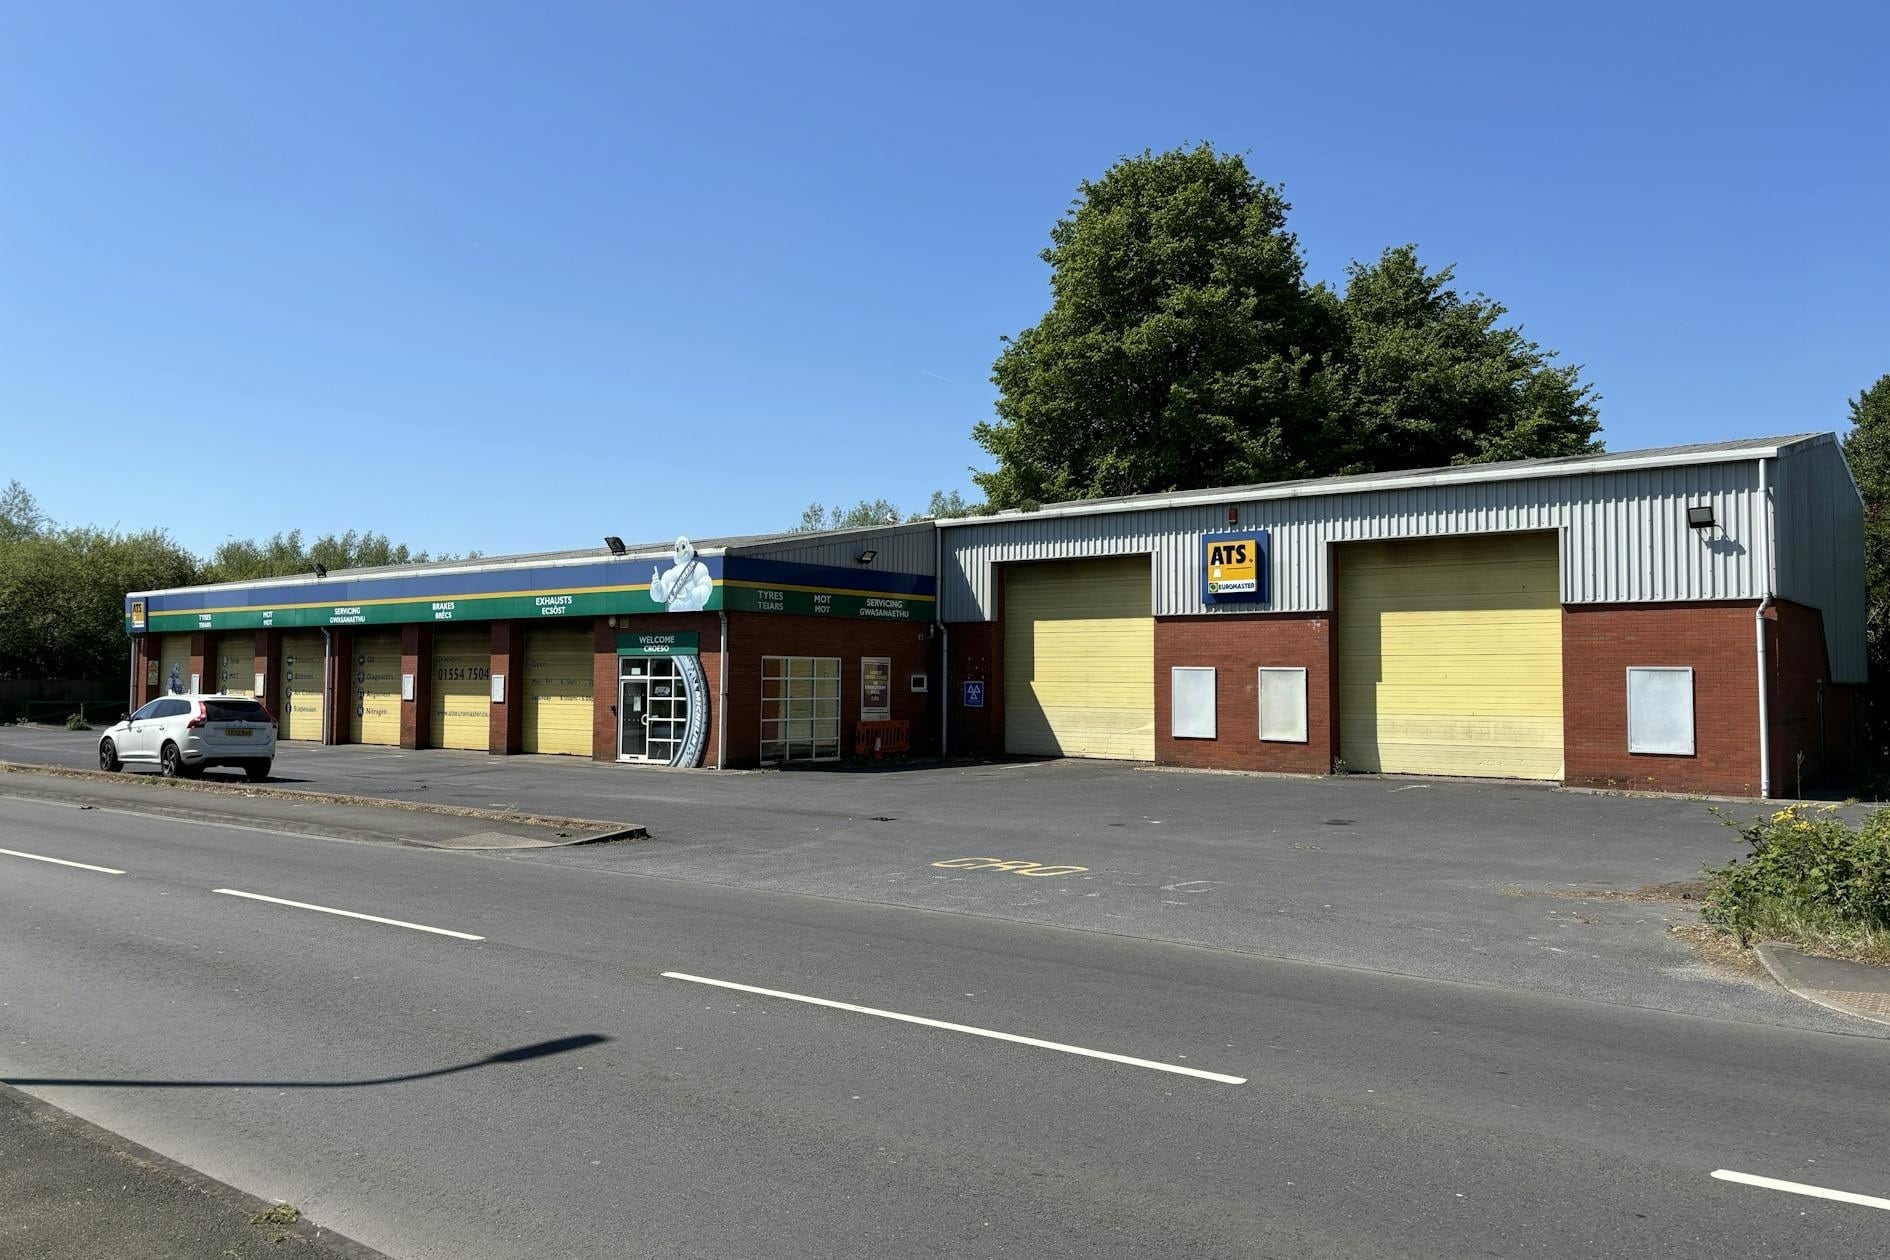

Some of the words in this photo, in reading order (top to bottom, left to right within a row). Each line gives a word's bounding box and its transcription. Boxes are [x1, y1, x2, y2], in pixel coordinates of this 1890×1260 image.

[1210, 544, 1246, 566] ATS
[1218, 582, 1255, 590] EUROMASTER
[758, 590, 784, 600] TYRES
[814, 594, 832, 604] MOT
[432, 602, 454, 610] BRAKES
[536, 596, 572, 606] EXHAUSTS
[758, 602, 784, 610] TEIARS
[866, 598, 902, 608] SERVICING
[334, 607, 360, 615] SERVICING
[814, 605, 830, 614] MOT
[860, 608, 909, 618] GWASANAETHU
[639, 636, 675, 644] WELCOME
[438, 668, 464, 680] 01554
[468, 668, 490, 680] 7504
